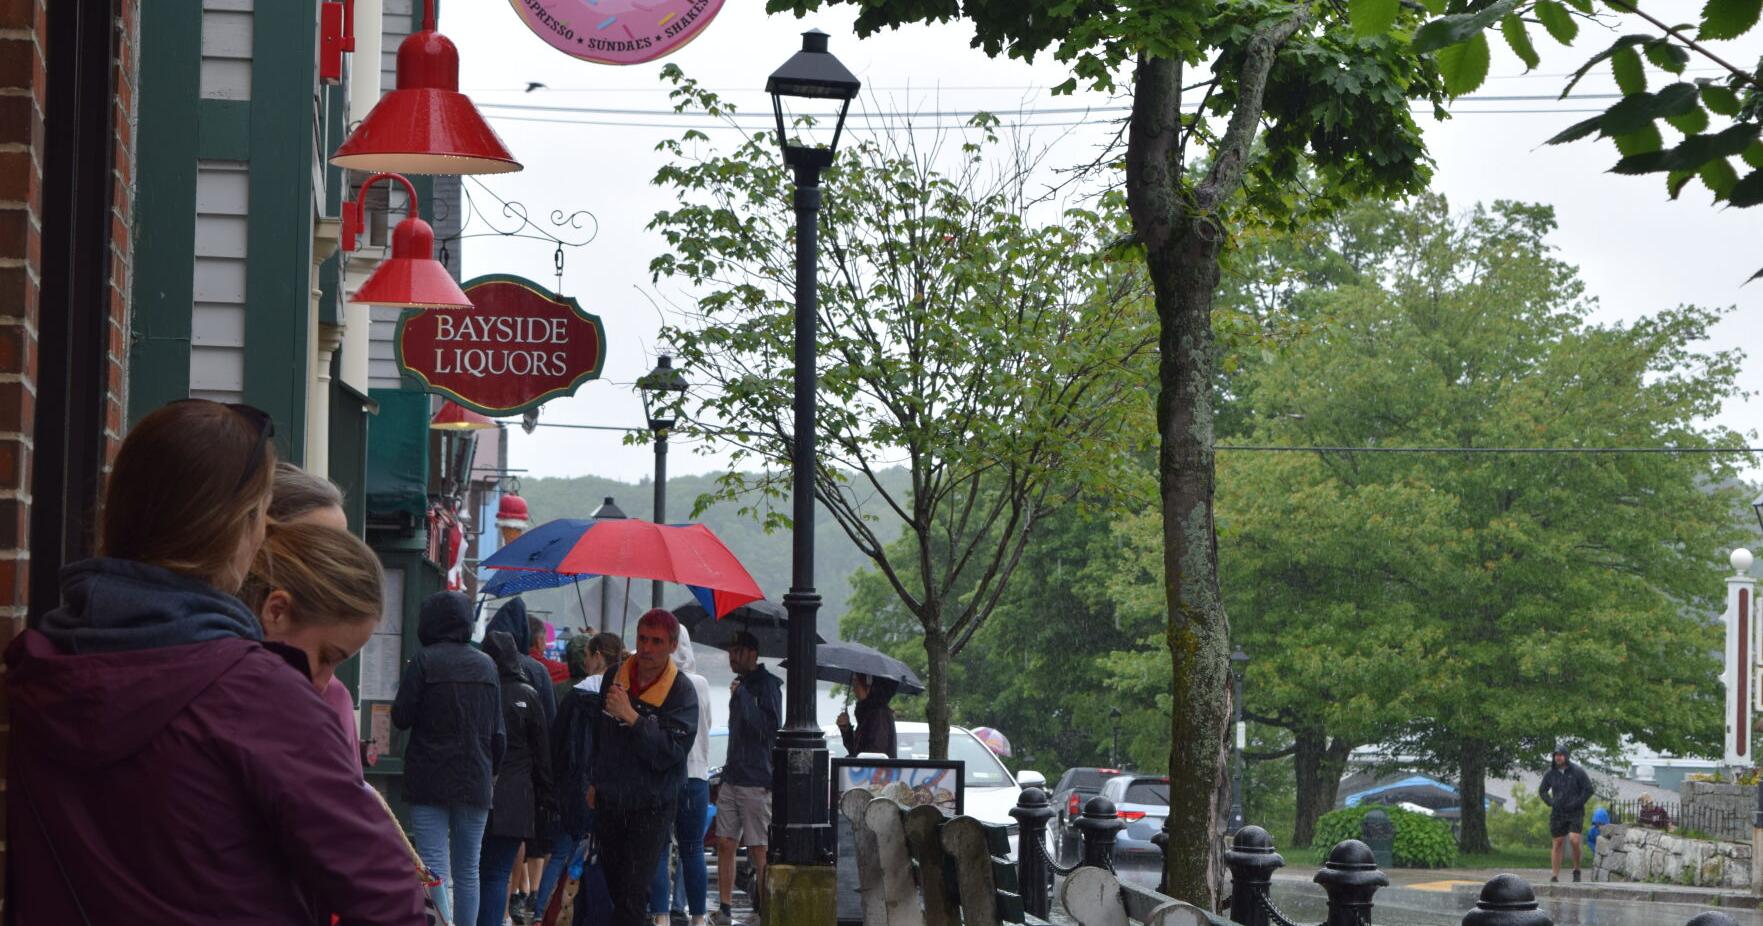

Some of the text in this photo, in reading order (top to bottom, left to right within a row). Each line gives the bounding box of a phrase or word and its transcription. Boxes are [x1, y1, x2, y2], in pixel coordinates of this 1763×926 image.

[588, 37, 652, 51] SUNDAES
[435, 315, 569, 344] BAYSIDE
[434, 349, 567, 377] LIQUORS
